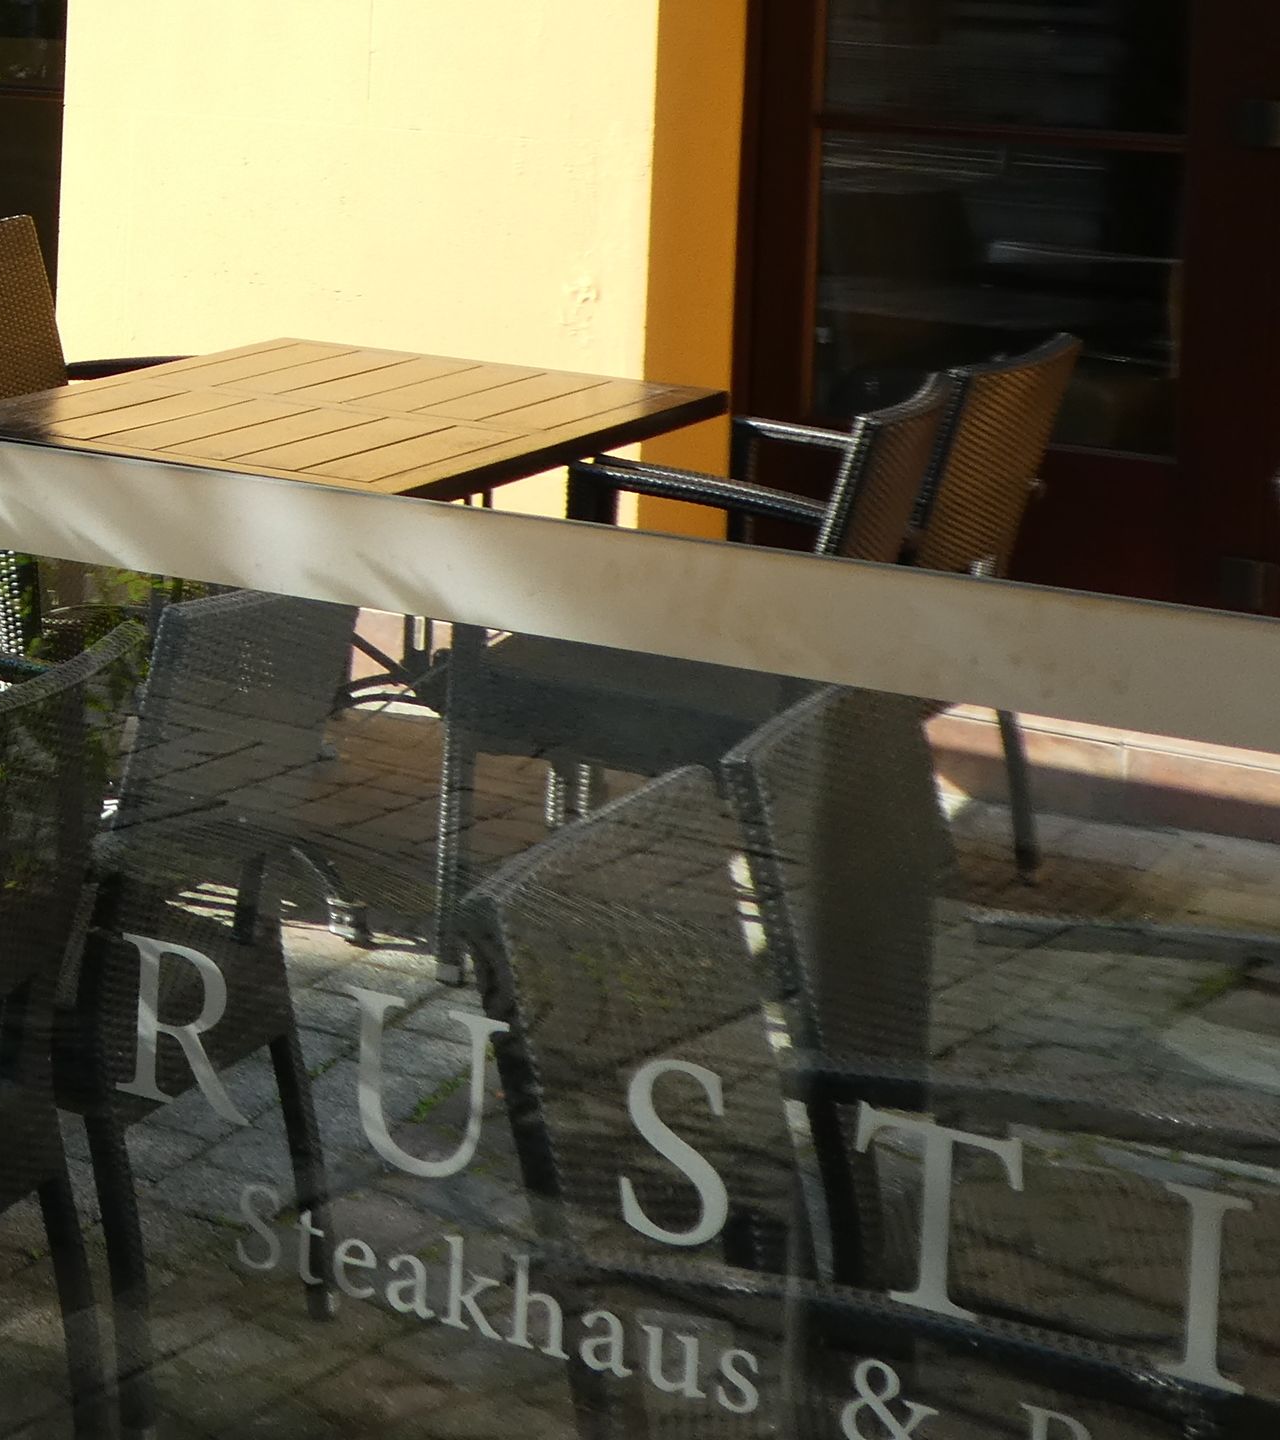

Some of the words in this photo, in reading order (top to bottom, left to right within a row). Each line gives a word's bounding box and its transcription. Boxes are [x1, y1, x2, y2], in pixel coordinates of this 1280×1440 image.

[115, 932, 1247, 1395] RUSTI
[235, 1183, 761, 1415] Steakhaus
[841, 1360, 938, 1440] &
